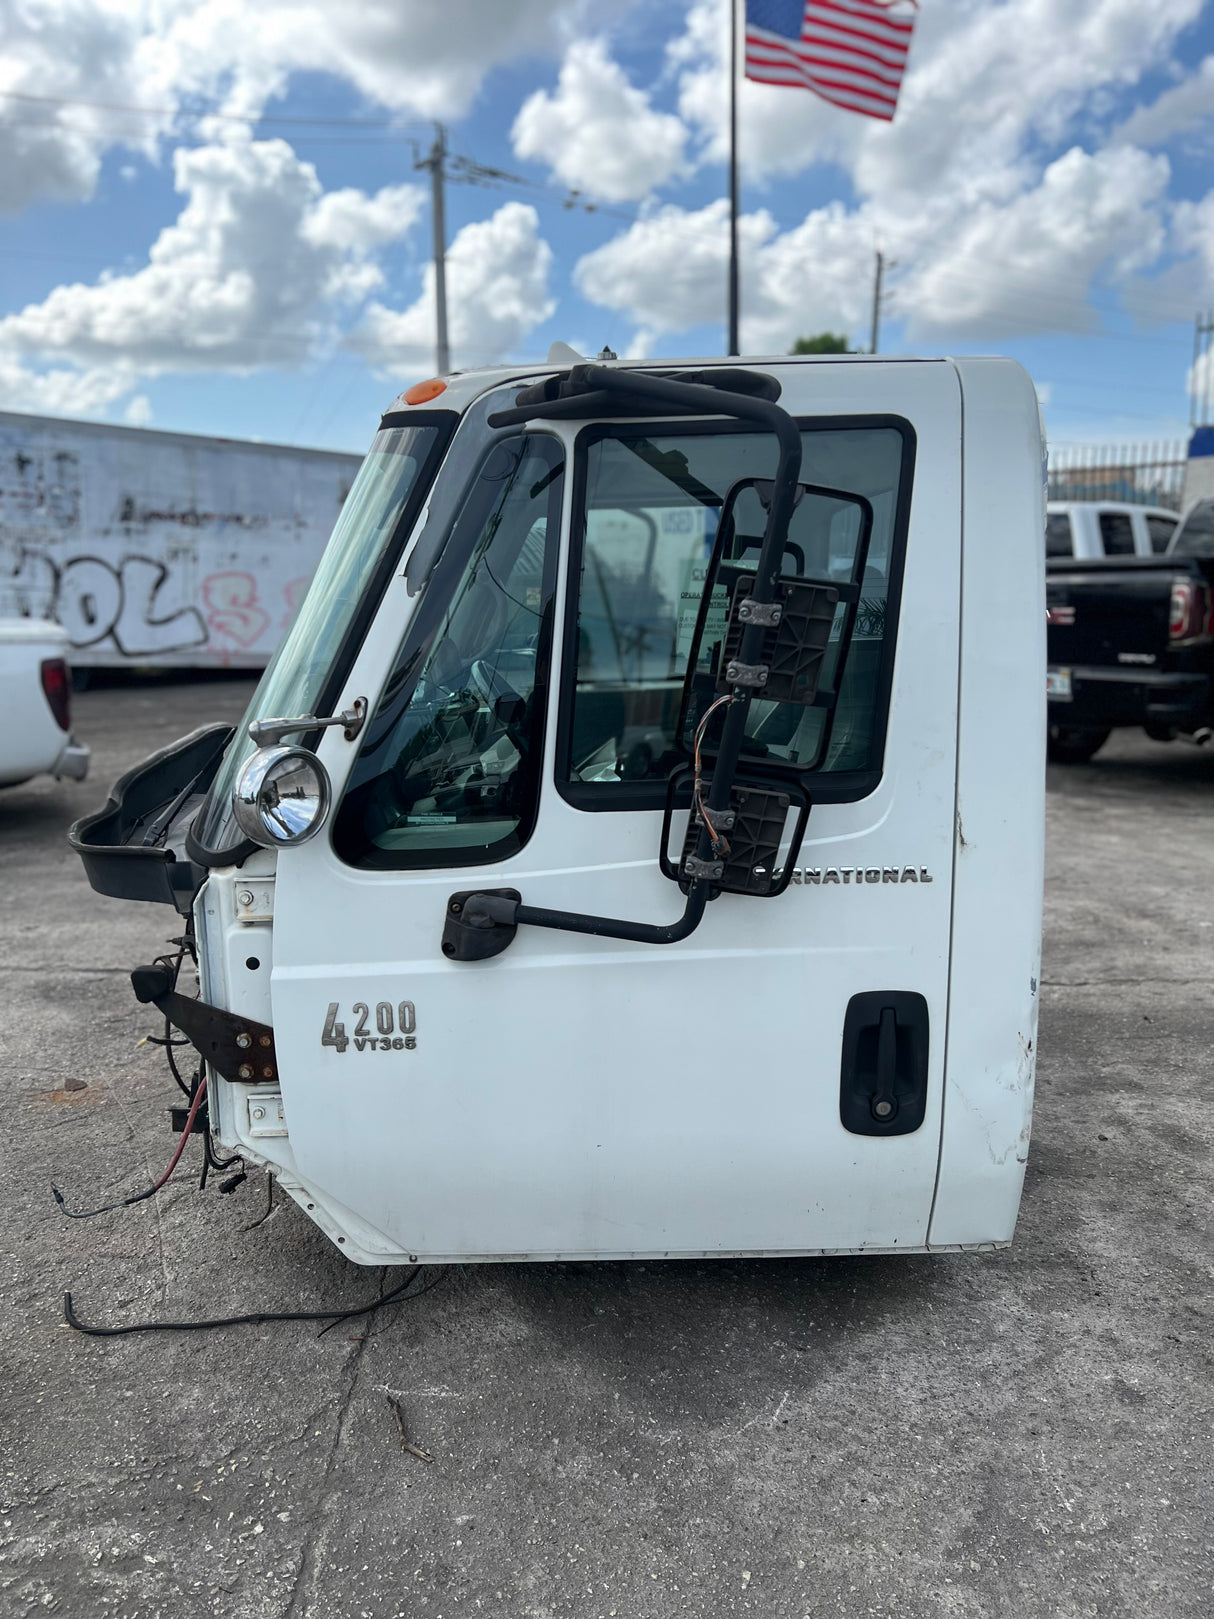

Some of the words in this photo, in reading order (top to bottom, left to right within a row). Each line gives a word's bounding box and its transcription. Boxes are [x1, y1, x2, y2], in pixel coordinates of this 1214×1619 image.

[772, 865, 933, 885] RNATIONAL
[321, 1000, 417, 1053] 4200
[353, 1035, 417, 1052] VT365
